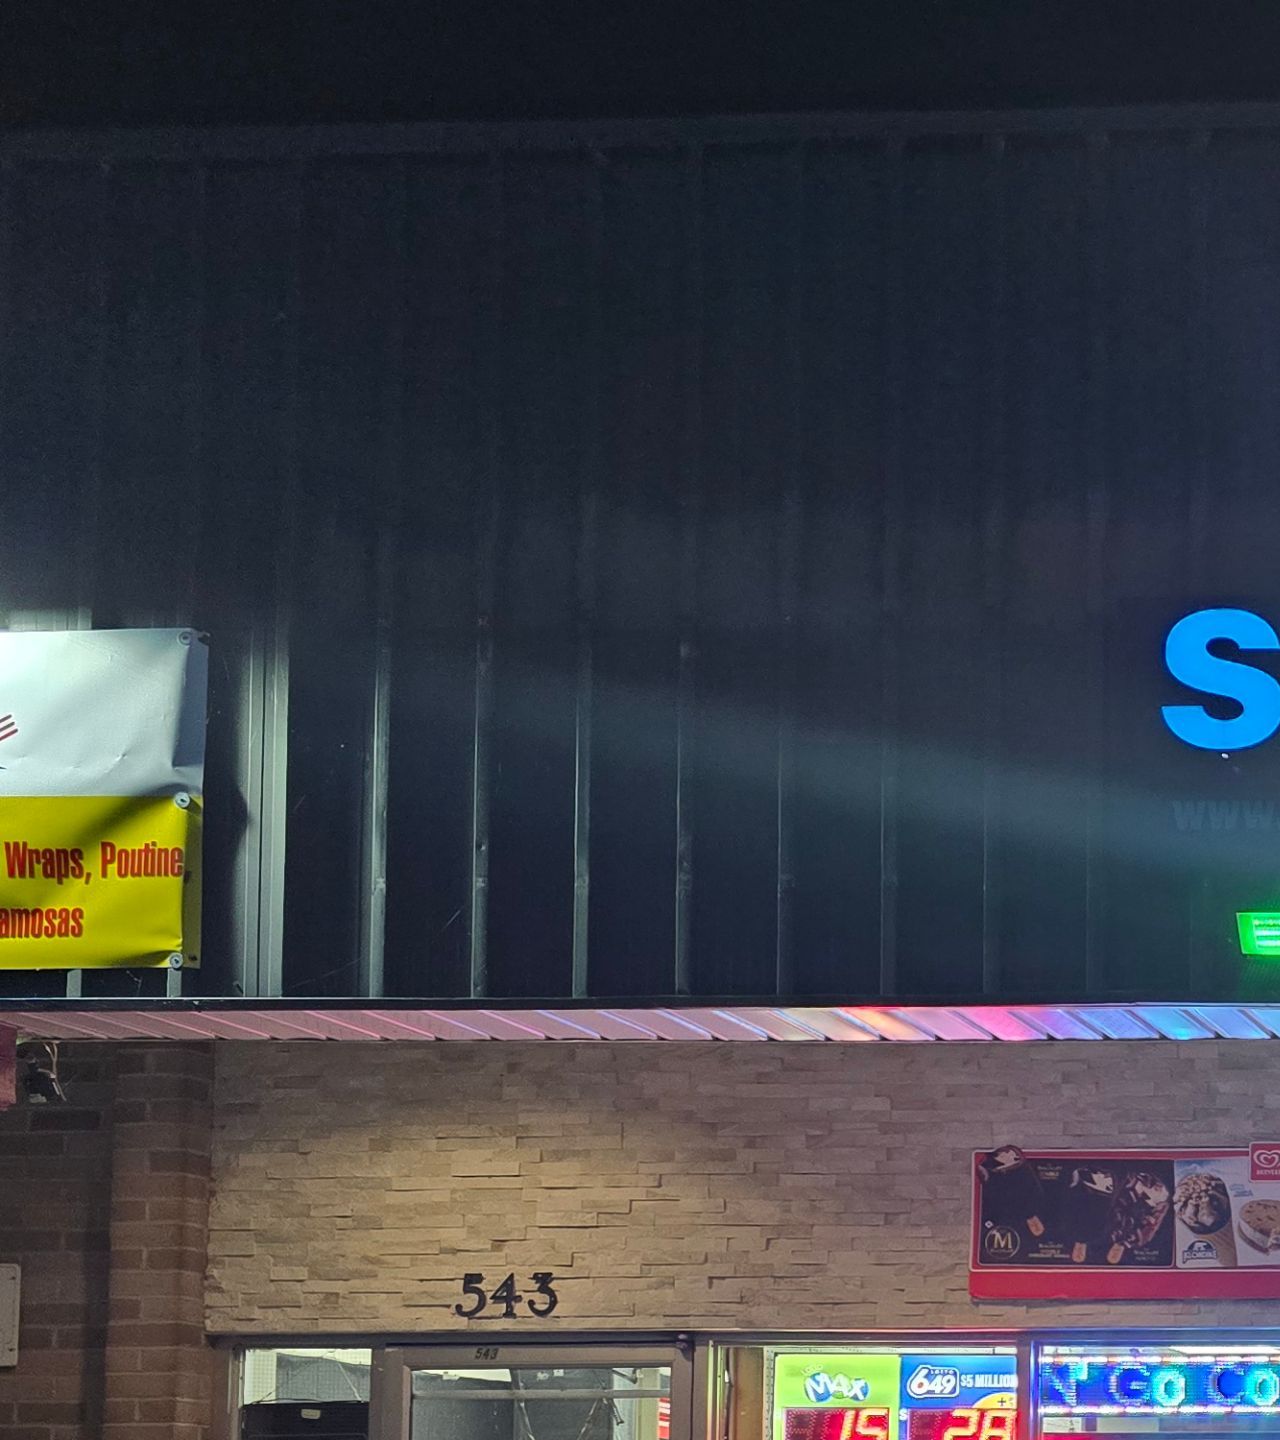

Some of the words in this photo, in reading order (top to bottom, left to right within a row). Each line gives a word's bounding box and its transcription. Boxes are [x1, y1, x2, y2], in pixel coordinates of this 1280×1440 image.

[4, 841, 92, 885] Wraps,
[455, 1272, 558, 1319] 543
[475, 1348, 499, 1361] 543
